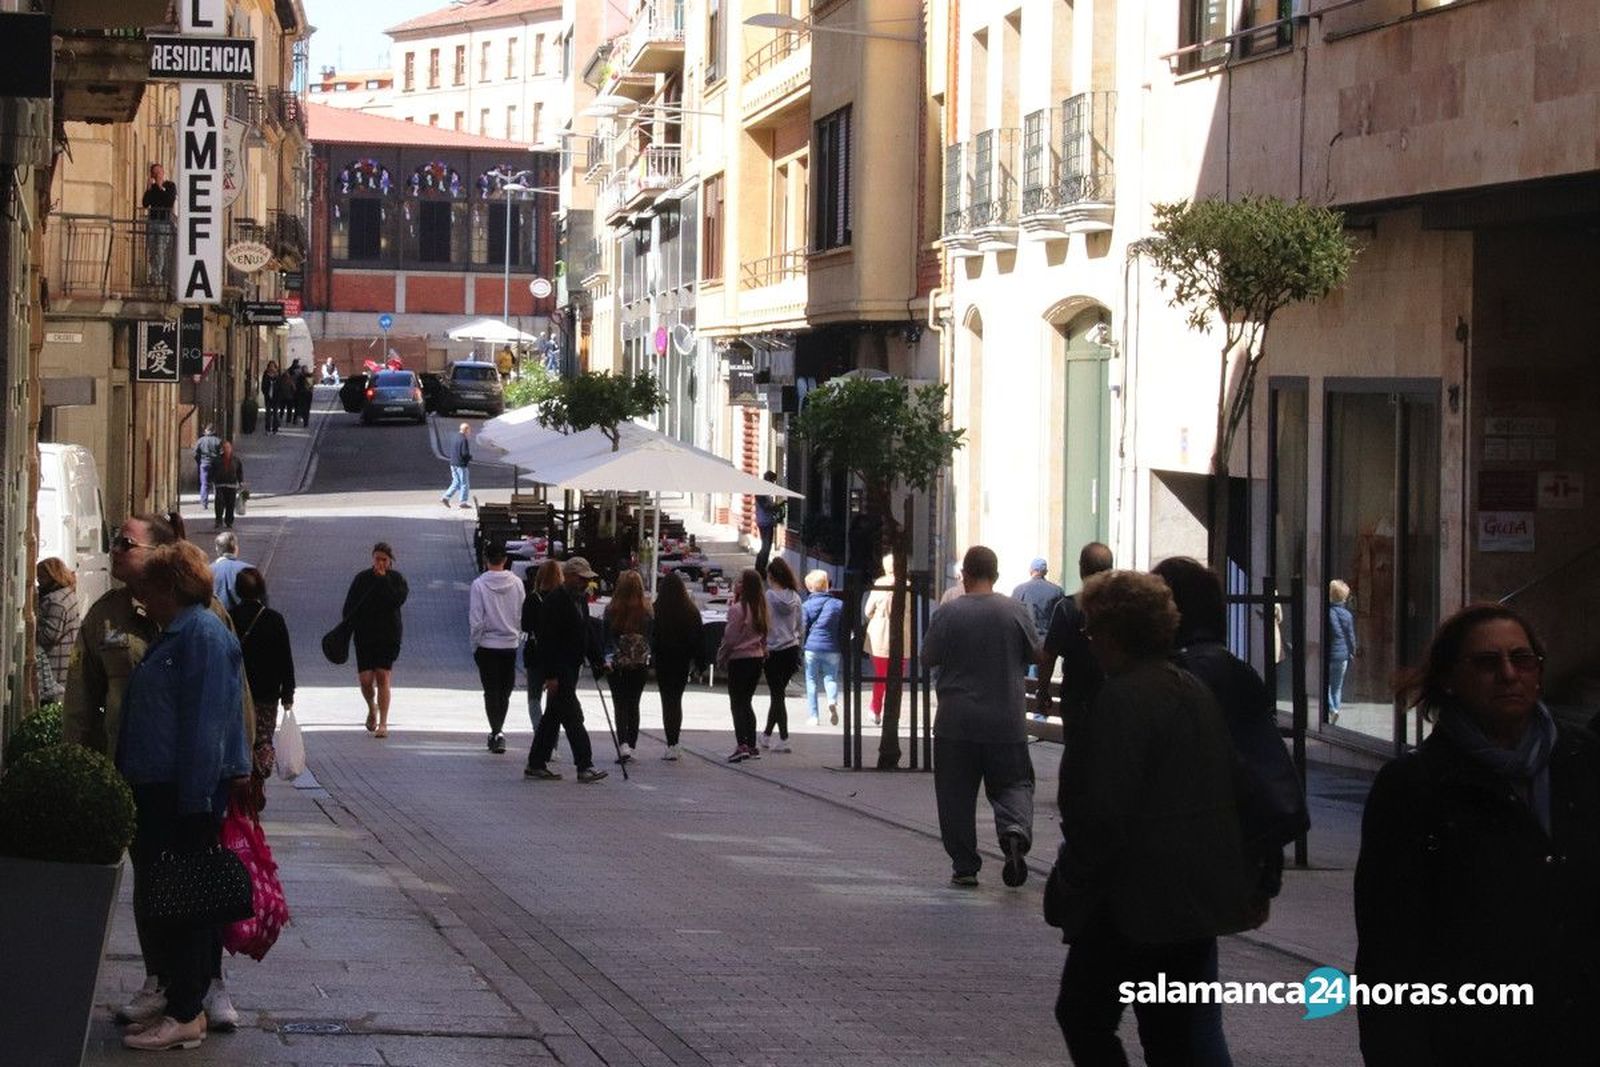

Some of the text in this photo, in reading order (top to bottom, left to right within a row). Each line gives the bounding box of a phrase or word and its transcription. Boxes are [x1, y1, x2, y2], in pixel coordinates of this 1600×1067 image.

[151, 45, 253, 73] RESIDENCIA
[185, 88, 217, 299] AMEFA
[231, 253, 264, 265] VENUS
[147, 340, 175, 374] 愛
